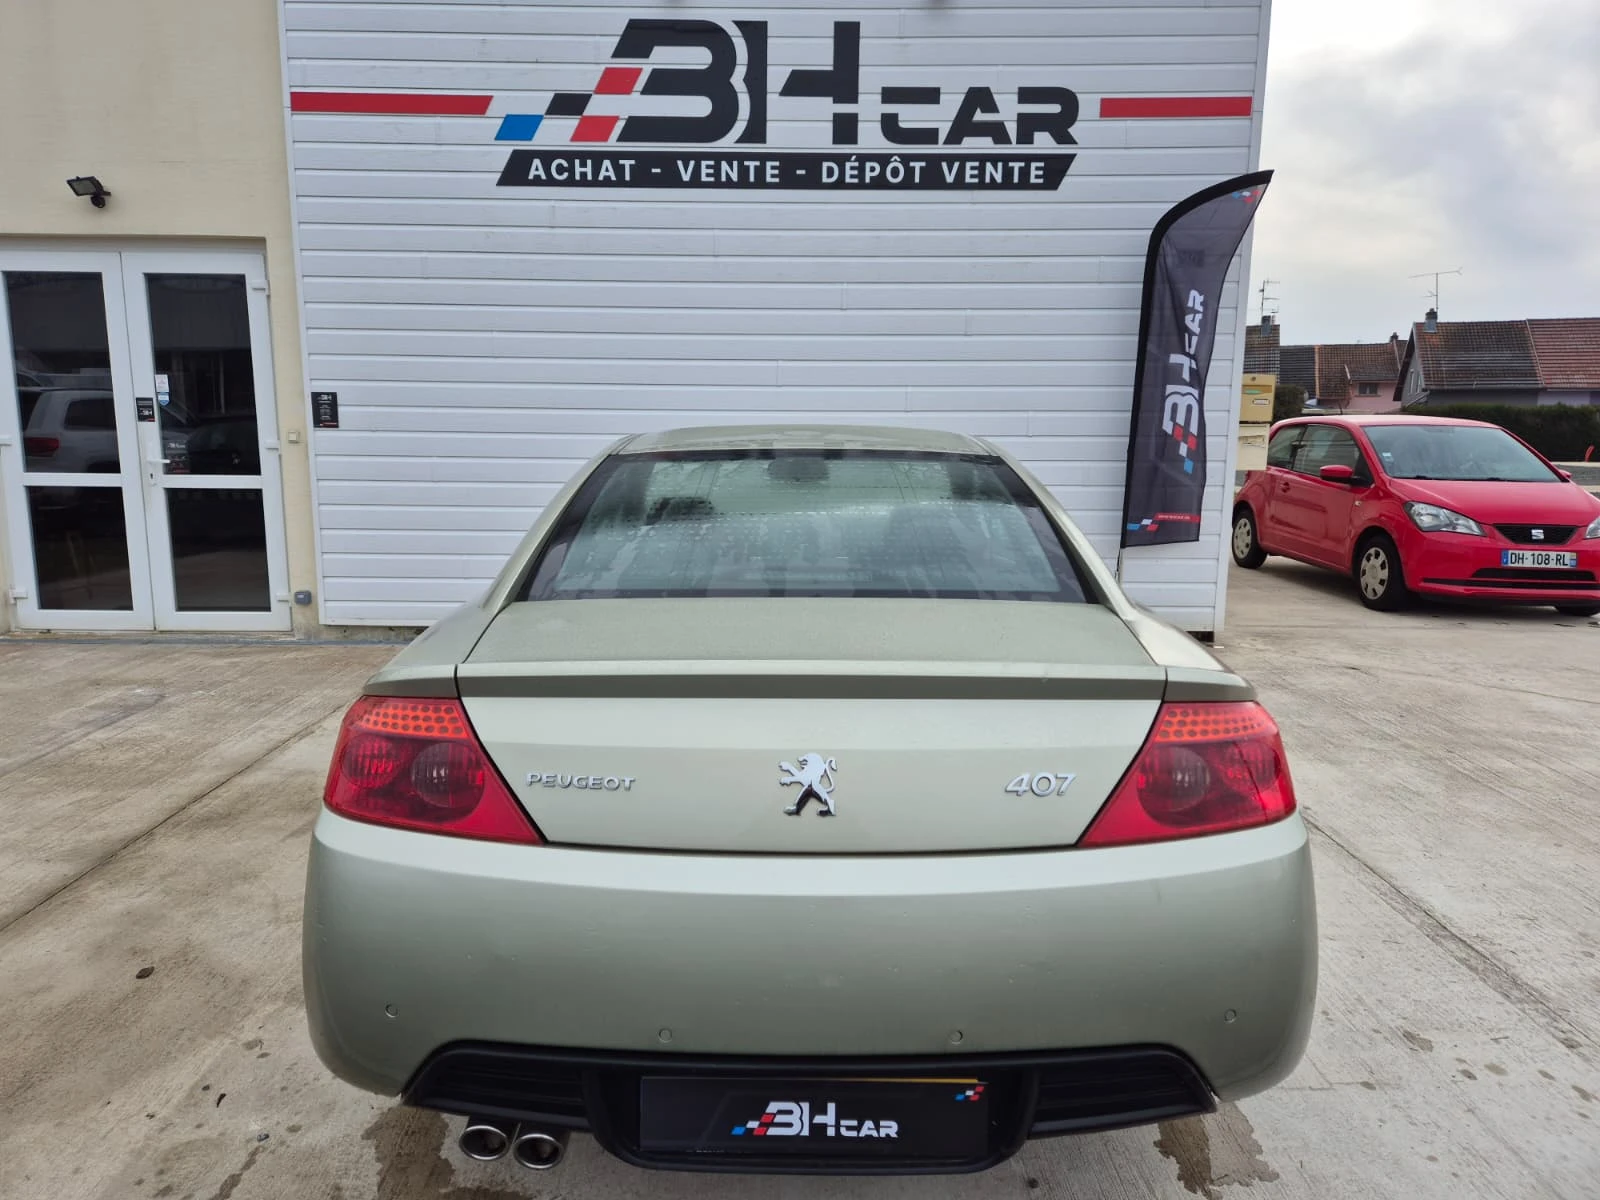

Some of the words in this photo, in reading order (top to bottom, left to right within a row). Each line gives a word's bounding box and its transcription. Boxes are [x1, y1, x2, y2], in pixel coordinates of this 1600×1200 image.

[527, 158, 636, 181] ACHAT
[676, 160, 780, 183] VENTE
[821, 155, 927, 183] DÉPÔT
[941, 161, 1046, 184] VENTE
[526, 772, 636, 791] PEUGEOT
[1004, 771, 1076, 797] 407
